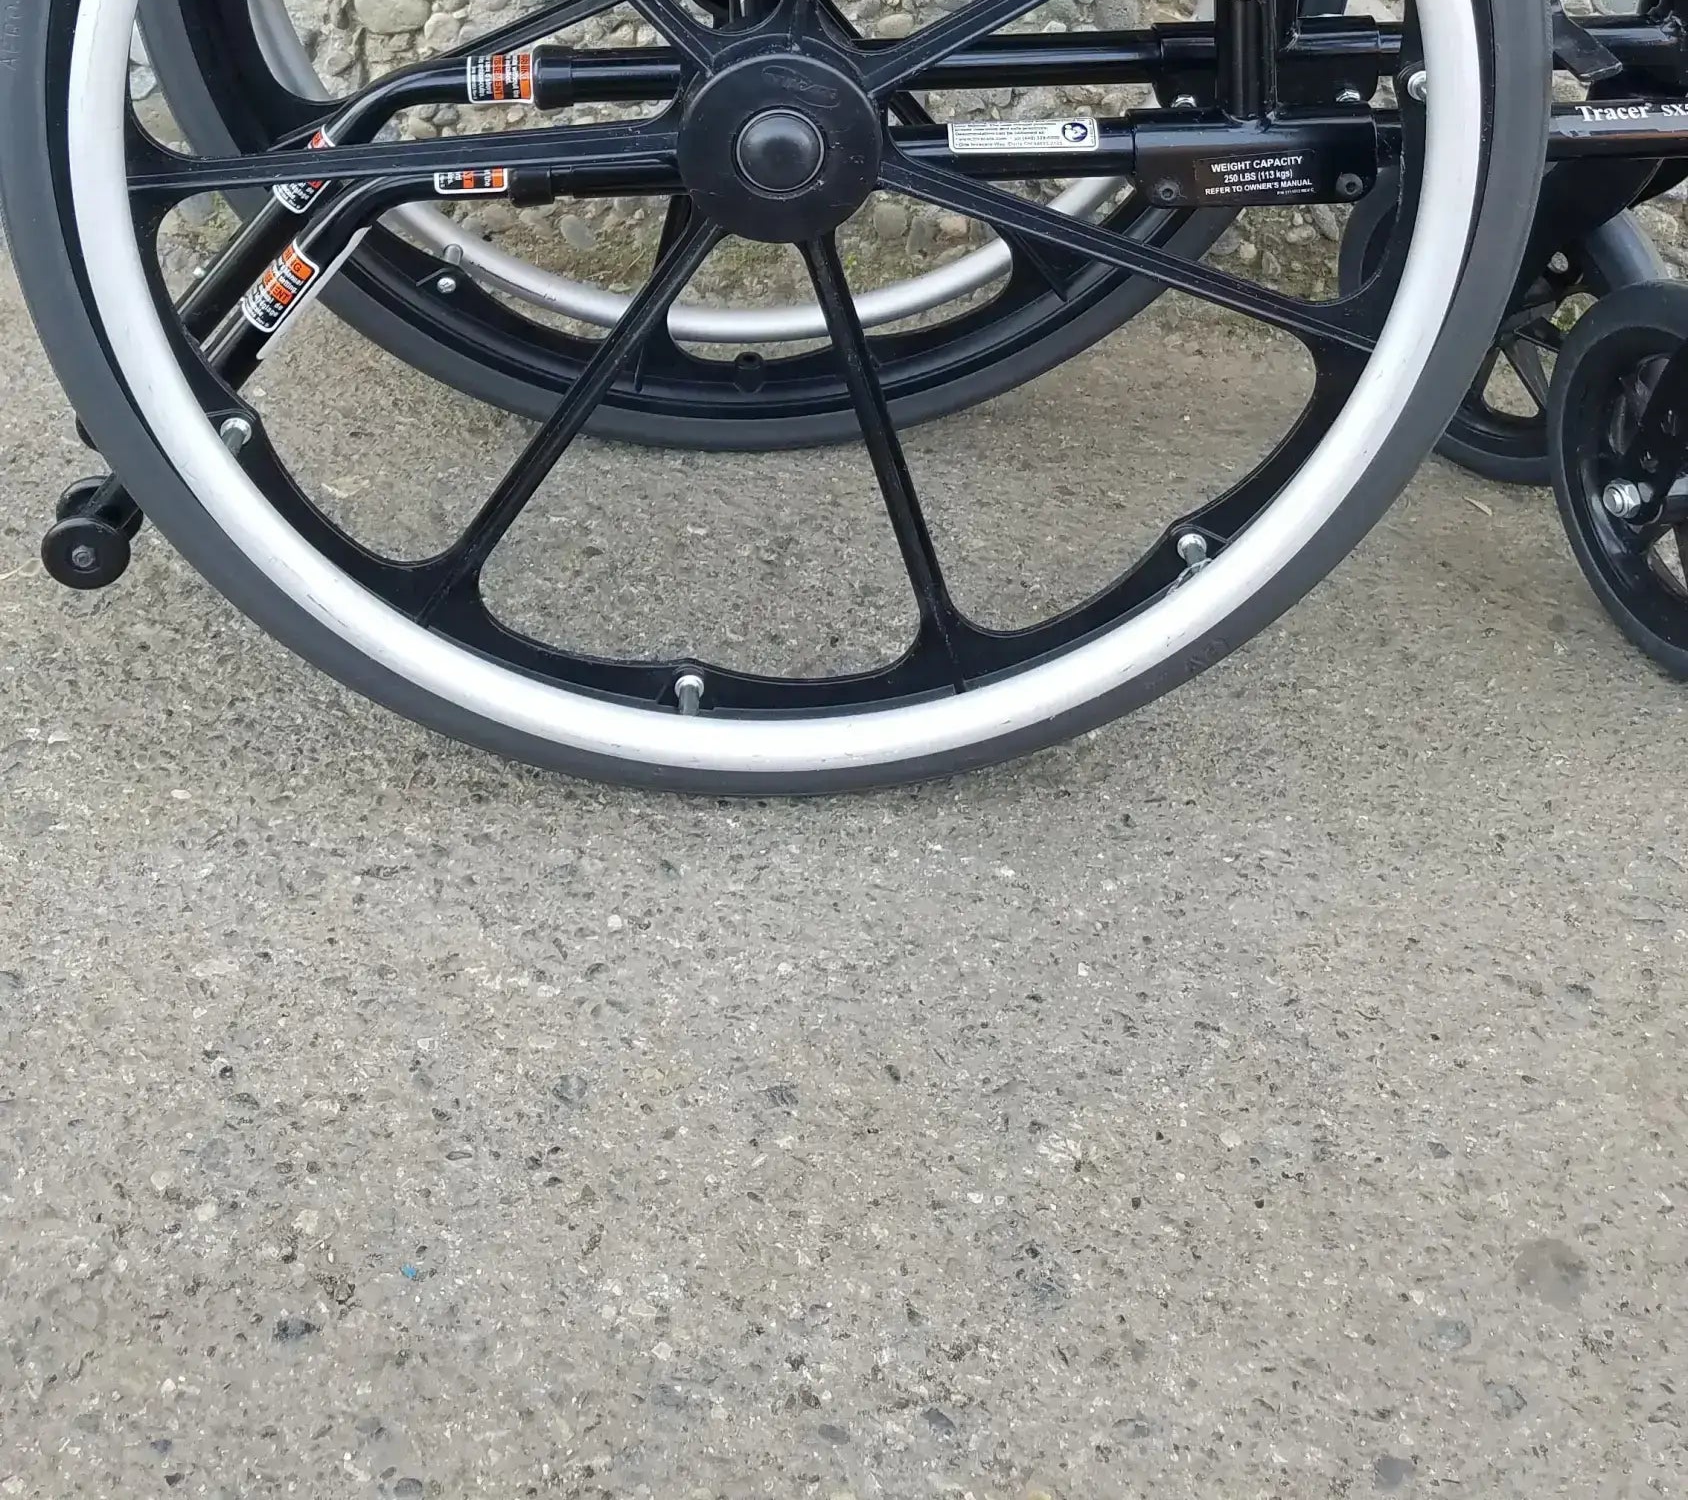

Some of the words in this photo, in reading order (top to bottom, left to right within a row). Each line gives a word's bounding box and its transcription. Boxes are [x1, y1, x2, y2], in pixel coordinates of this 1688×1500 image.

[1575, 104, 1649, 122] Tracer
[1211, 160, 1251, 173] WEIGHT
[1253, 155, 1303, 169] CAPACITY
[1224, 173, 1239, 184] 250
[1240, 172, 1256, 182] LBS
[1258, 170, 1275, 182] (113
[1276, 168, 1293, 180] kgs)
[1205, 185, 1231, 196] REFER
[1232, 184, 1243, 193] TO
[1244, 181, 1279, 192] OWNER'S
[1280, 178, 1313, 189] MANUAL
